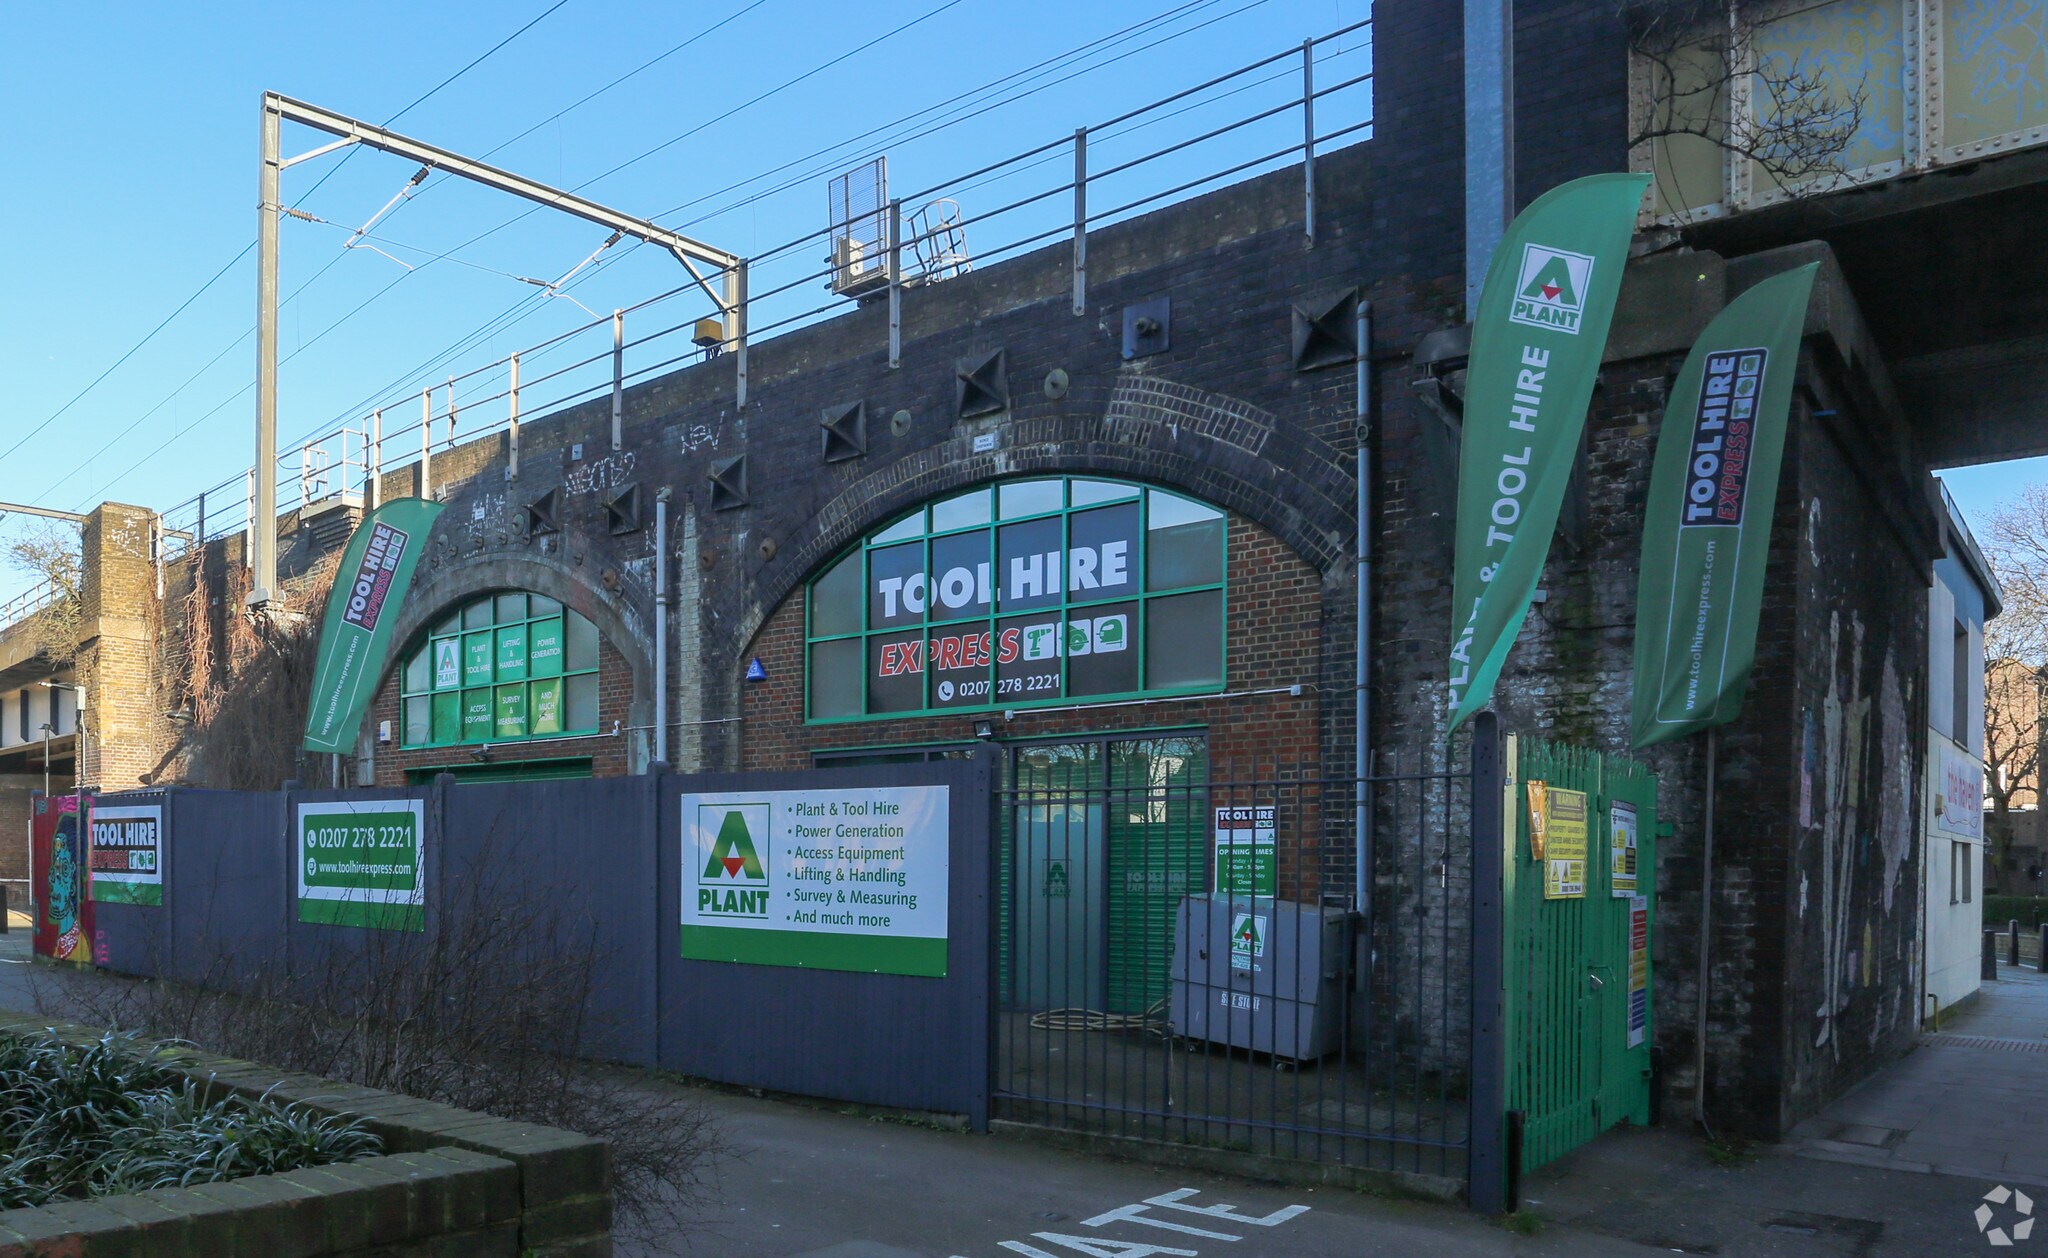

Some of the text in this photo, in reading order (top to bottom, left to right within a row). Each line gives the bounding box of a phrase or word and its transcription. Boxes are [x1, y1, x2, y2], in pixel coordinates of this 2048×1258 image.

[1513, 301, 1579, 328] PLANT
[1508, 345, 1550, 433] HIRE
[1687, 356, 1736, 522] TOOL HIRE
[1717, 421, 1749, 521] EXPRESS
[1486, 446, 1532, 546] TOOL
[347, 525, 392, 622] TOOL HIRE
[879, 540, 1128, 617] TOOL HIRE
[1480, 562, 1500, 582] &
[362, 569, 391, 628] EXPRESS
[1686, 540, 1716, 711] www.toolhireexpress.com
[472, 645, 486, 653] PLANT
[503, 638, 520, 648] LIFTING
[537, 637, 556, 647] POWER
[531, 648, 561, 659] GENERATION
[878, 628, 1020, 677] EXPRESS
[467, 664, 491, 674] TOOL HIRE
[499, 659, 524, 669] HANDLING
[321, 635, 360, 736] www.toolhireexpress.com
[438, 673, 457, 683] PLANT
[959, 673, 1060, 697] 0207 278 2221
[502, 695, 521, 704] SURVEY
[541, 692, 553, 700] AND
[539, 702, 555, 711] MUCH
[796, 801, 899, 816] Plant & Tool Hire
[93, 822, 155, 846] TOOL HIRE
[319, 826, 411, 848] 0207 278 2221
[795, 824, 904, 838] Power Generation
[93, 849, 128, 869] EXPRESS
[795, 846, 904, 864] Access Equipment
[319, 860, 411, 878] www.toolhireexpress.com
[794, 867, 906, 887] Lifting & Handling
[698, 888, 769, 914] PLANT
[794, 889, 917, 910] Survey & Measuring
[794, 910, 891, 927] And much more
